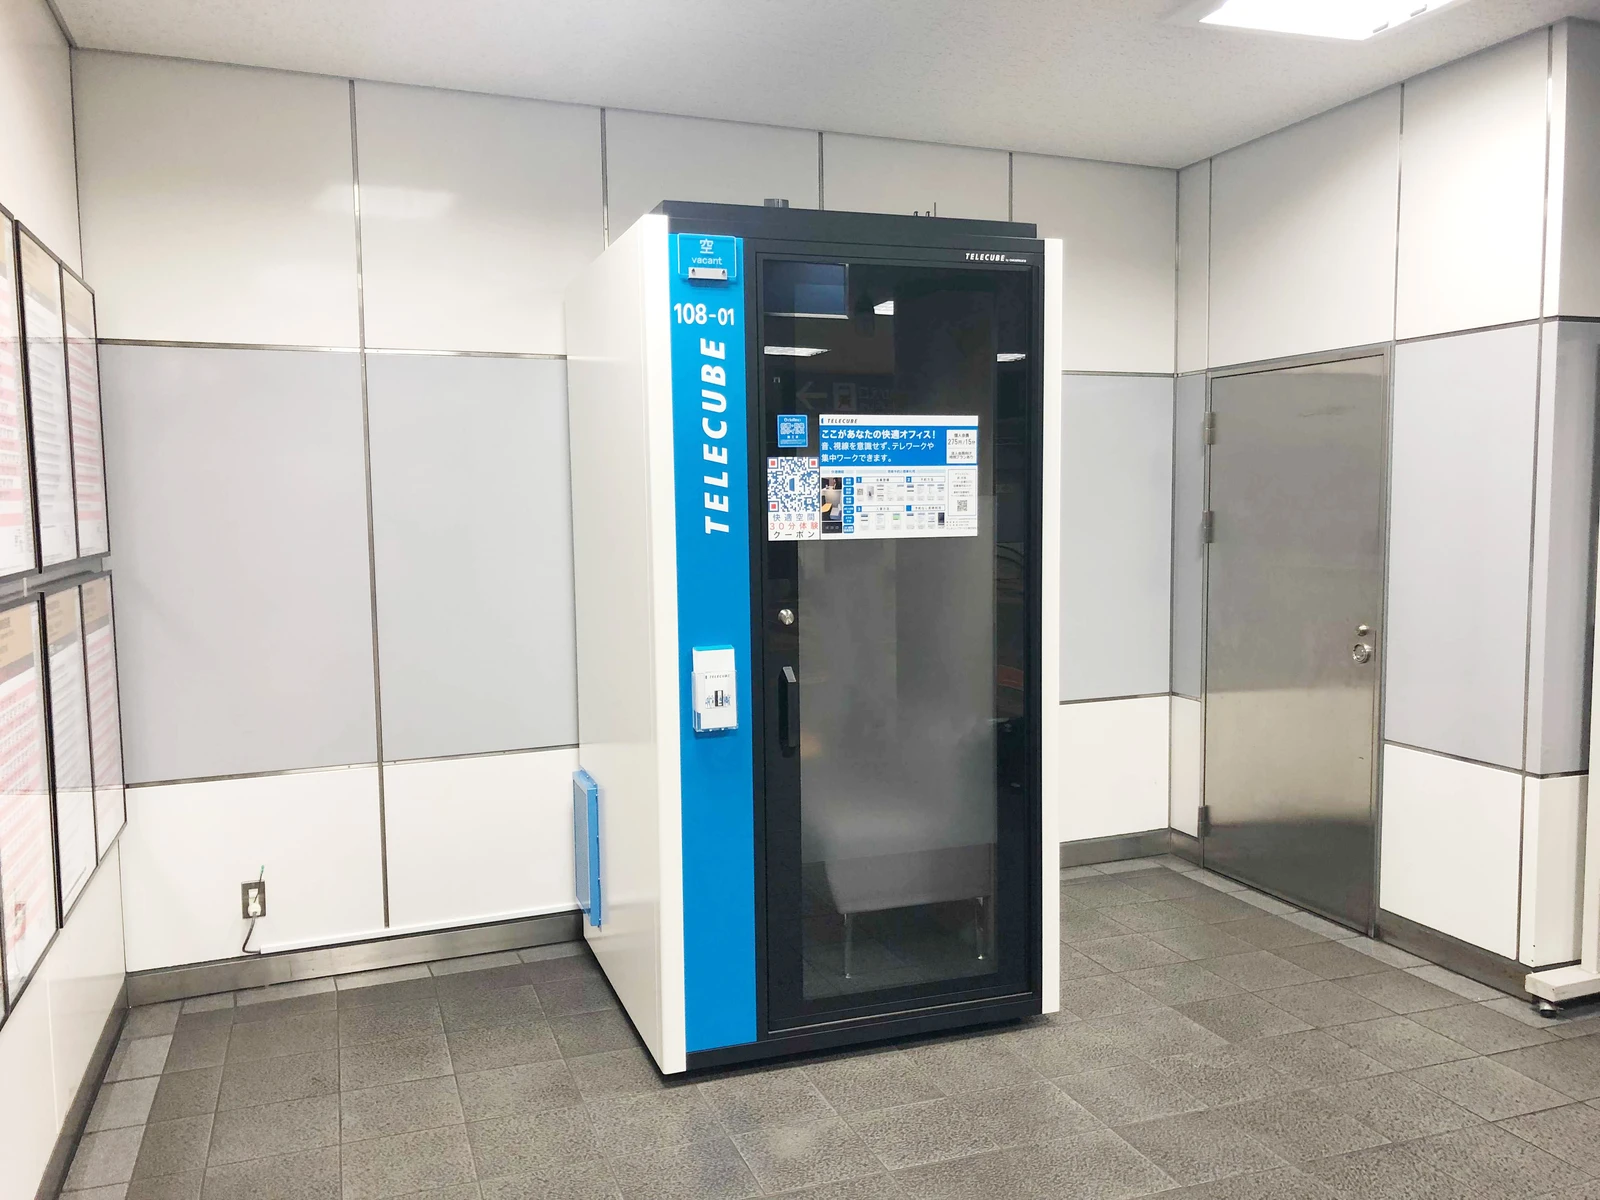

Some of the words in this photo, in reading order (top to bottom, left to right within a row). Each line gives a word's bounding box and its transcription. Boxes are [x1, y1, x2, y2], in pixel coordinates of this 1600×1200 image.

[699, 238, 715, 255] 空
[691, 256, 723, 266] vacant
[965, 252, 1006, 263] TELECUBE
[673, 302, 735, 326] 108-01
[699, 337, 730, 535] TELECUBE
[821, 441, 935, 451] 音、視線を意識せず、テレワークや
[821, 453, 892, 464] 集中ワークできます。
[772, 513, 815, 522] 快適空間
[769, 521, 819, 531] 30分体験
[773, 530, 815, 539] クーポン
